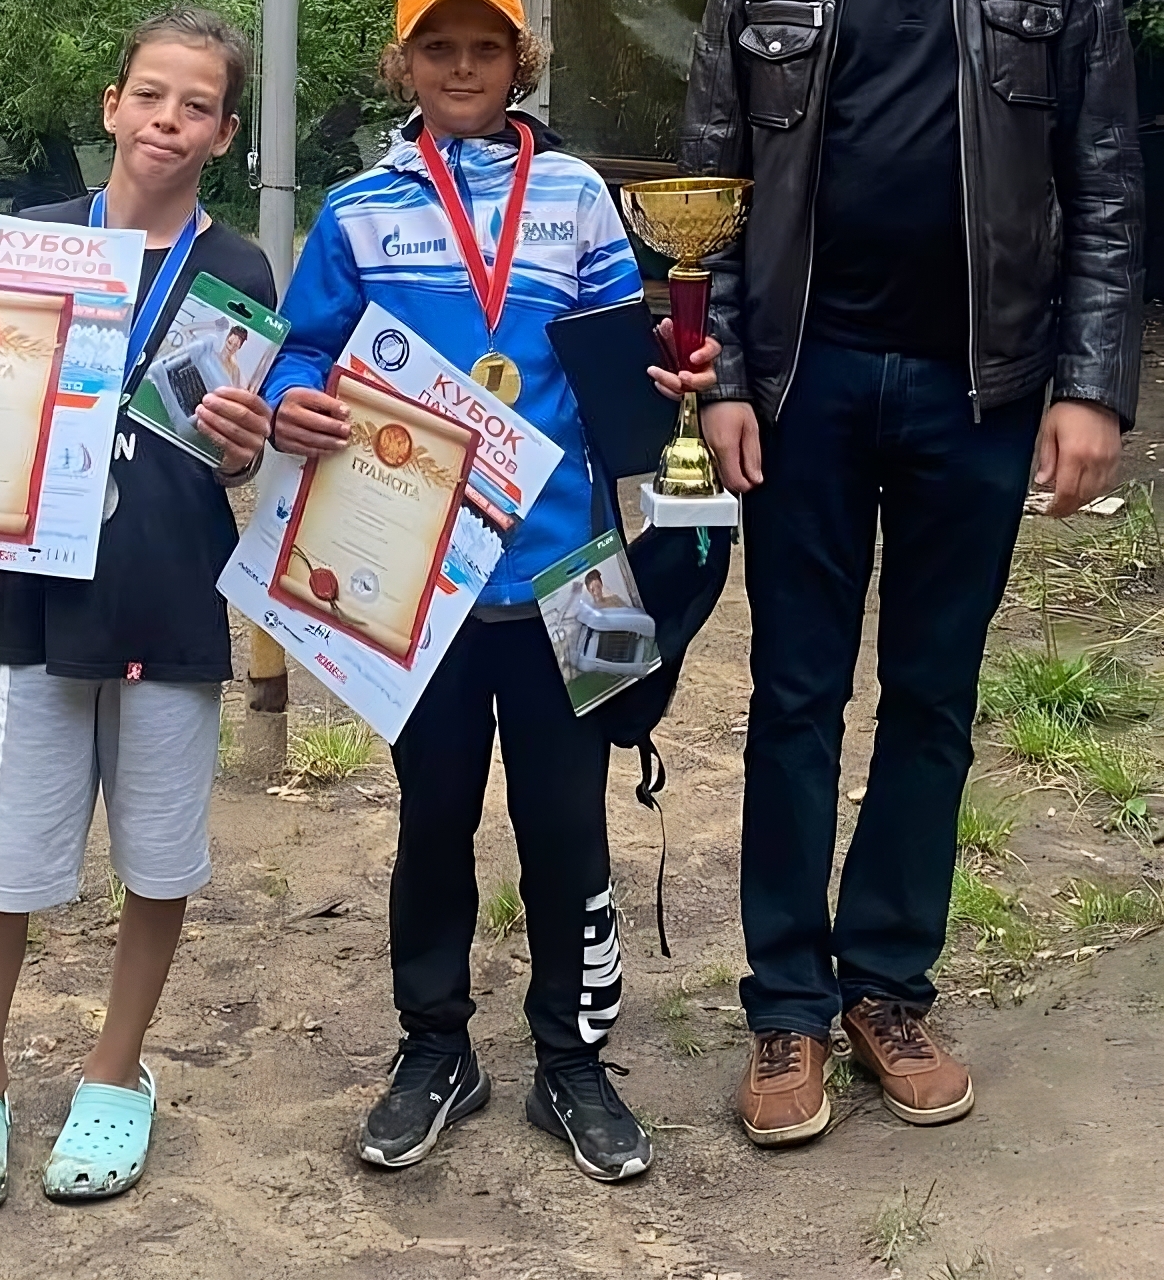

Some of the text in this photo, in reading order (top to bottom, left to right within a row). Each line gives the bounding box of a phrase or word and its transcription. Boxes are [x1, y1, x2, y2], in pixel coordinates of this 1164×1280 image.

[418, 389, 518, 475] ПАТОТОВ
[433, 372, 525, 456] КУБОК
[352, 455, 420, 501] ГРАМОТА
